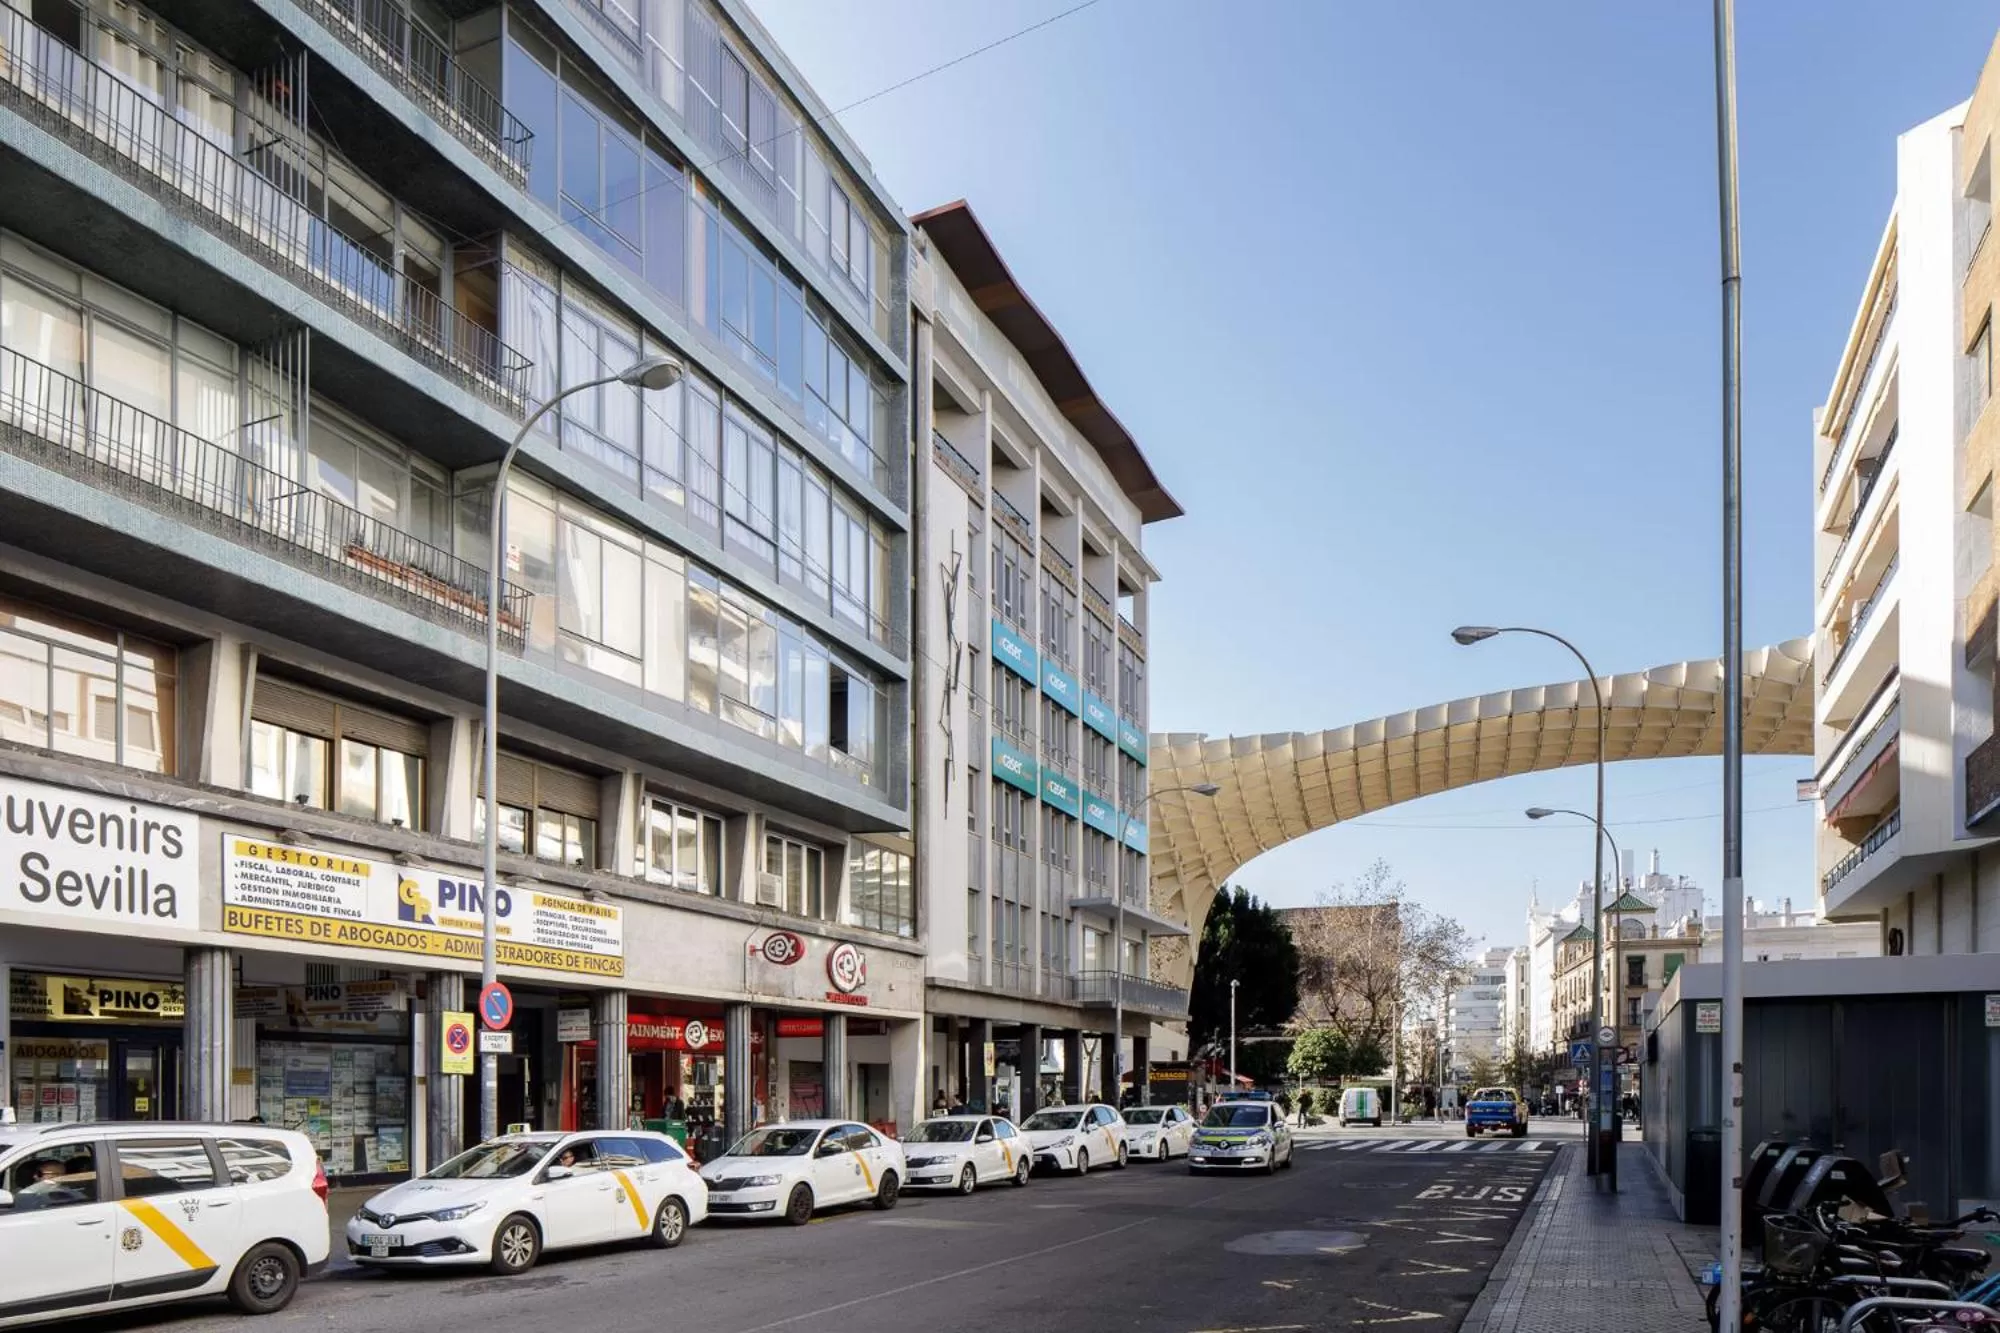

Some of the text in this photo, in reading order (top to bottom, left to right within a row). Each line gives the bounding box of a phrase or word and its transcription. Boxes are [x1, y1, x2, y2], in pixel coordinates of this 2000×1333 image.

[0, 795, 183, 859] uvenirs
[248, 844, 360, 873] GESTORIA
[19, 852, 177, 919] Sevilla
[240, 883, 342, 905] GESTION INMOBILIARIA
[240, 894, 362, 918] ADMINISTRACION DE FINCAS
[438, 878, 512, 918] PINO
[542, 898, 576, 910] AGENCIA
[577, 904, 586, 913] DE
[228, 911, 304, 935] BUFETES
[310, 921, 332, 938] DE
[337, 926, 428, 950] ABOGADOS
[443, 938, 563, 967] ADMISTRADORES
[566, 954, 581, 968] DE
[583, 957, 623, 974] FINCAS
[99, 989, 160, 1010] PINO
[305, 985, 341, 1001] PINO
[16, 1044, 98, 1059] ABOGADOS
